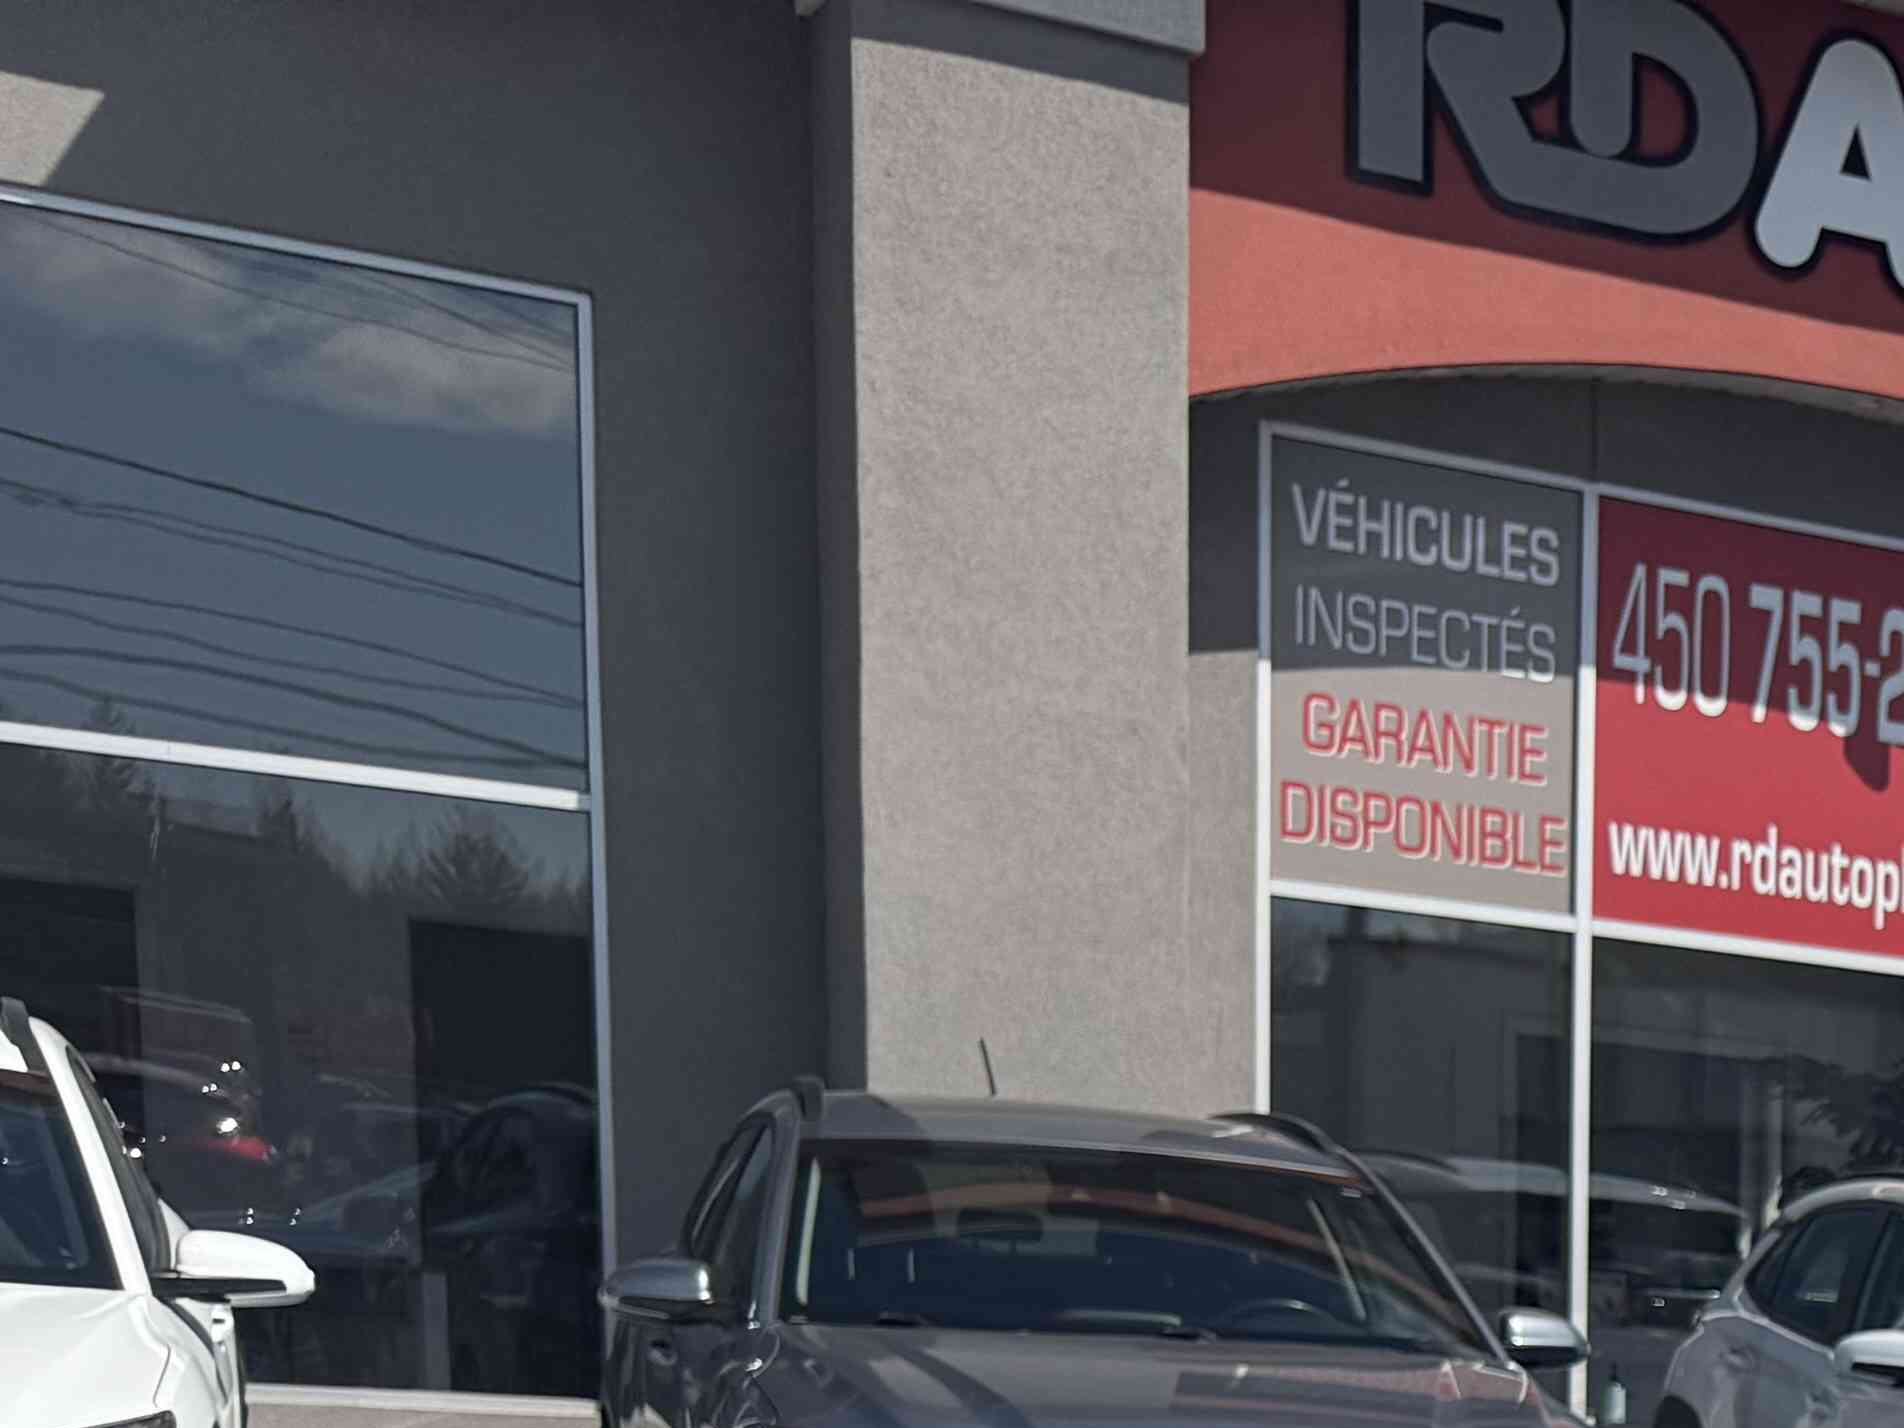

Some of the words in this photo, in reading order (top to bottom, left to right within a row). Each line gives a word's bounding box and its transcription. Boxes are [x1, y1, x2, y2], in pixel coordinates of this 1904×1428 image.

[1292, 478, 1560, 587] VÉHICULES
[1295, 584, 1555, 683] INSPECTÉS
[1613, 562, 1730, 717] 450
[1303, 692, 1549, 785] GARANTIE
[1279, 780, 1568, 878] DISPONIBLE
